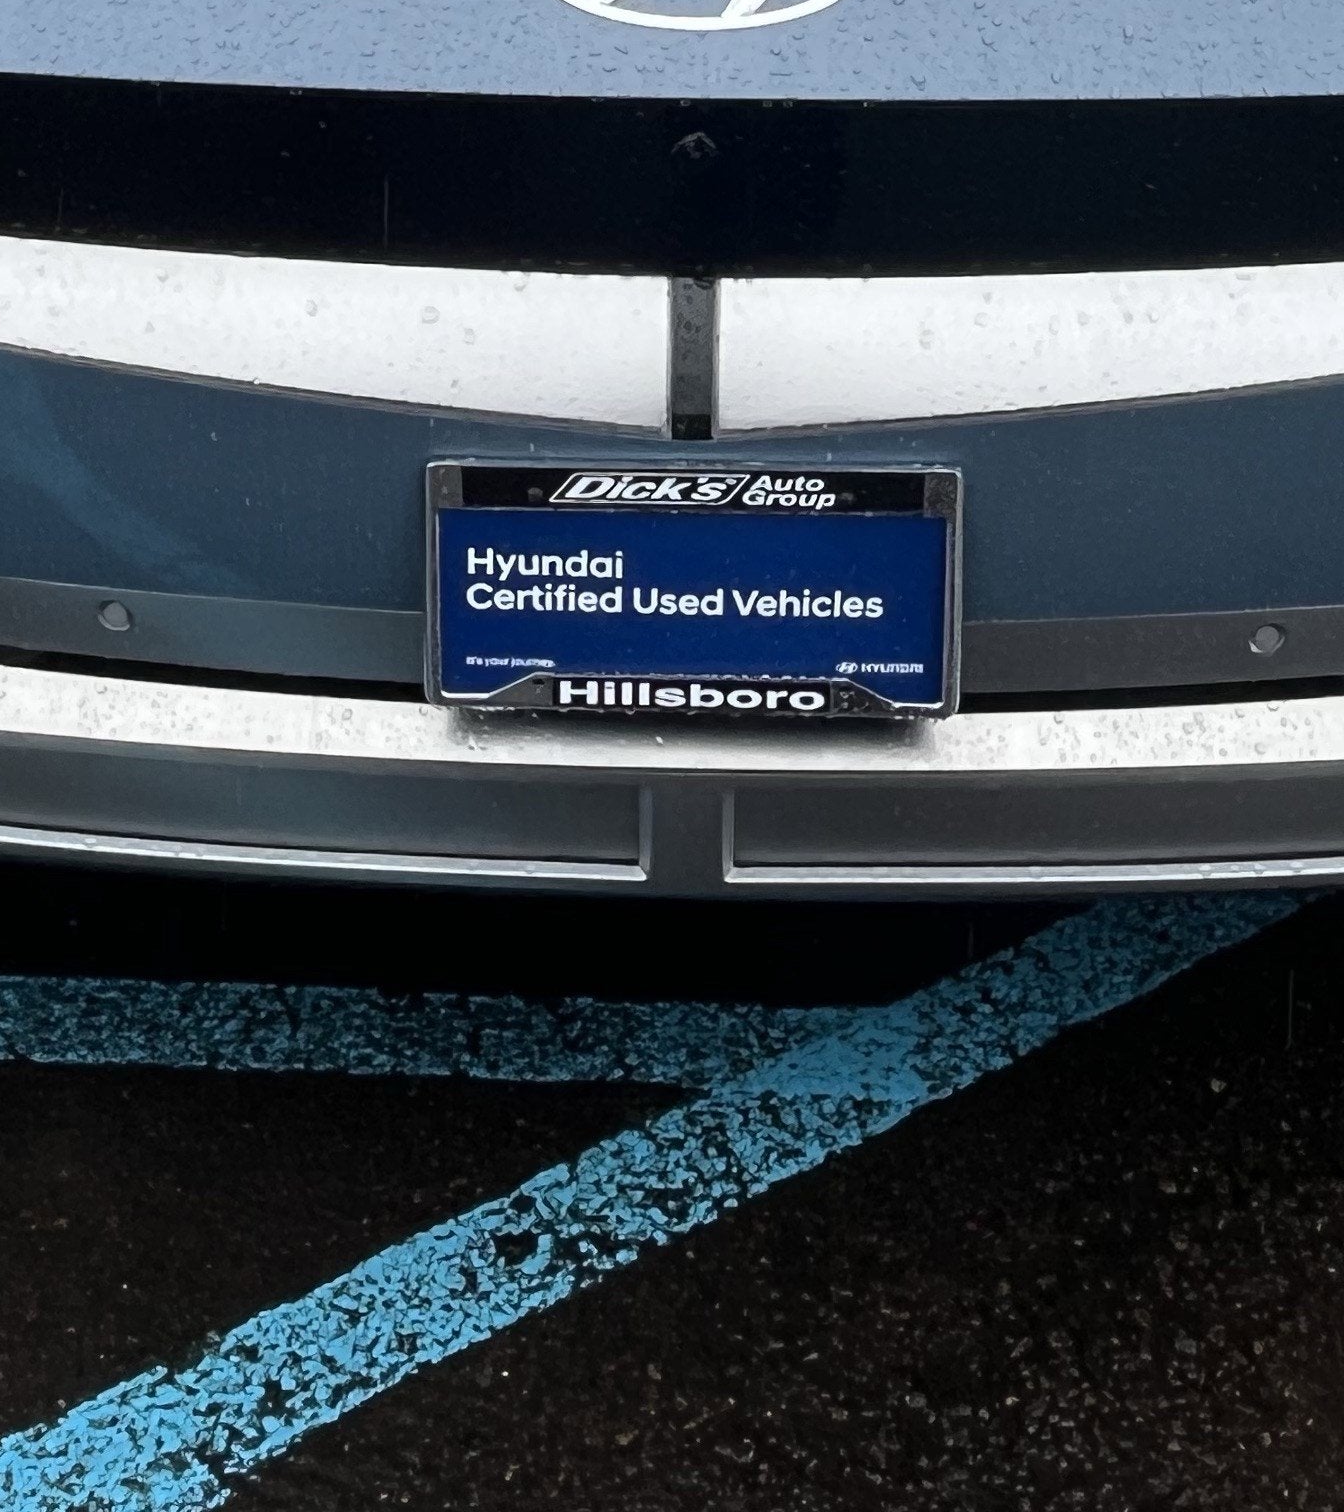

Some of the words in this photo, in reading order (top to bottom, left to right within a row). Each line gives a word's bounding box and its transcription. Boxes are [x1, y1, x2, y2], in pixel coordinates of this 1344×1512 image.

[749, 475, 825, 492] Auto
[741, 491, 836, 510] Group
[466, 547, 624, 580] Hyundai
[466, 583, 622, 614] Certified
[632, 589, 724, 617] Used
[732, 588, 884, 619] Vehicles
[559, 680, 825, 711] Hillsboro
